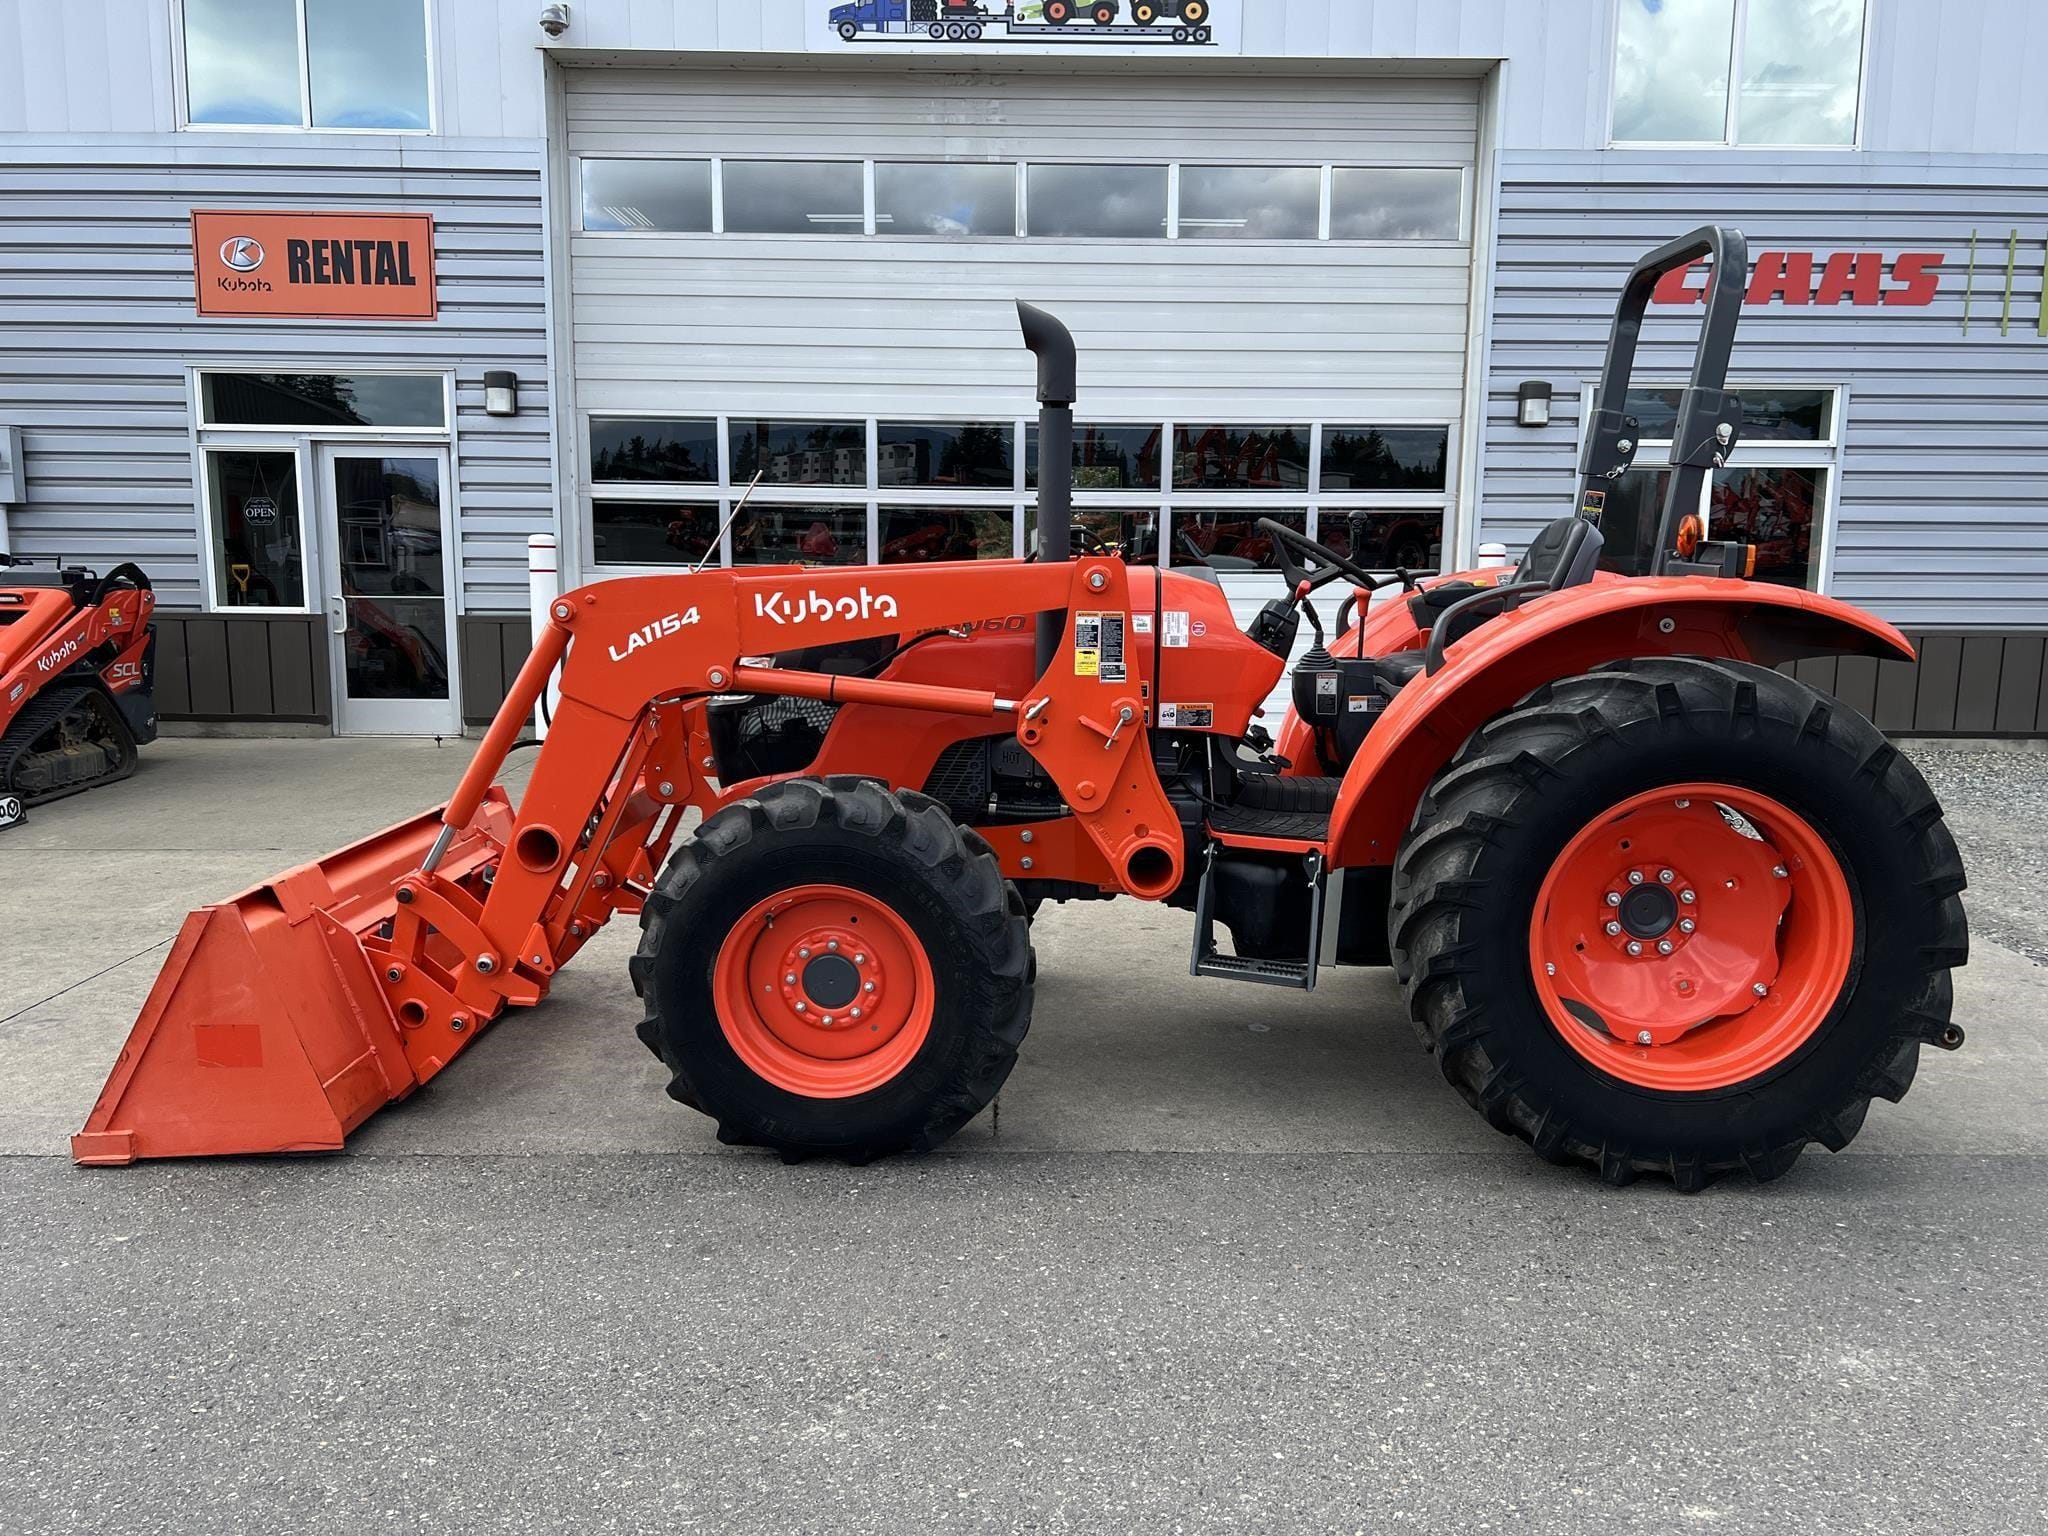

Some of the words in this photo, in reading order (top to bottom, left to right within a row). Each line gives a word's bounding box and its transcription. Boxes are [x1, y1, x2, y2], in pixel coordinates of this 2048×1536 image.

[286, 238, 417, 286] RENTAL
[217, 277, 272, 292] Kubota
[1651, 251, 1945, 306] CAAS
[245, 507, 276, 517] OPEN
[754, 586, 899, 625] Kubota
[608, 605, 701, 662] LA1154
[37, 640, 78, 671] Kubota
[112, 662, 140, 678] SCL
[1002, 750, 1021, 764] HOT
